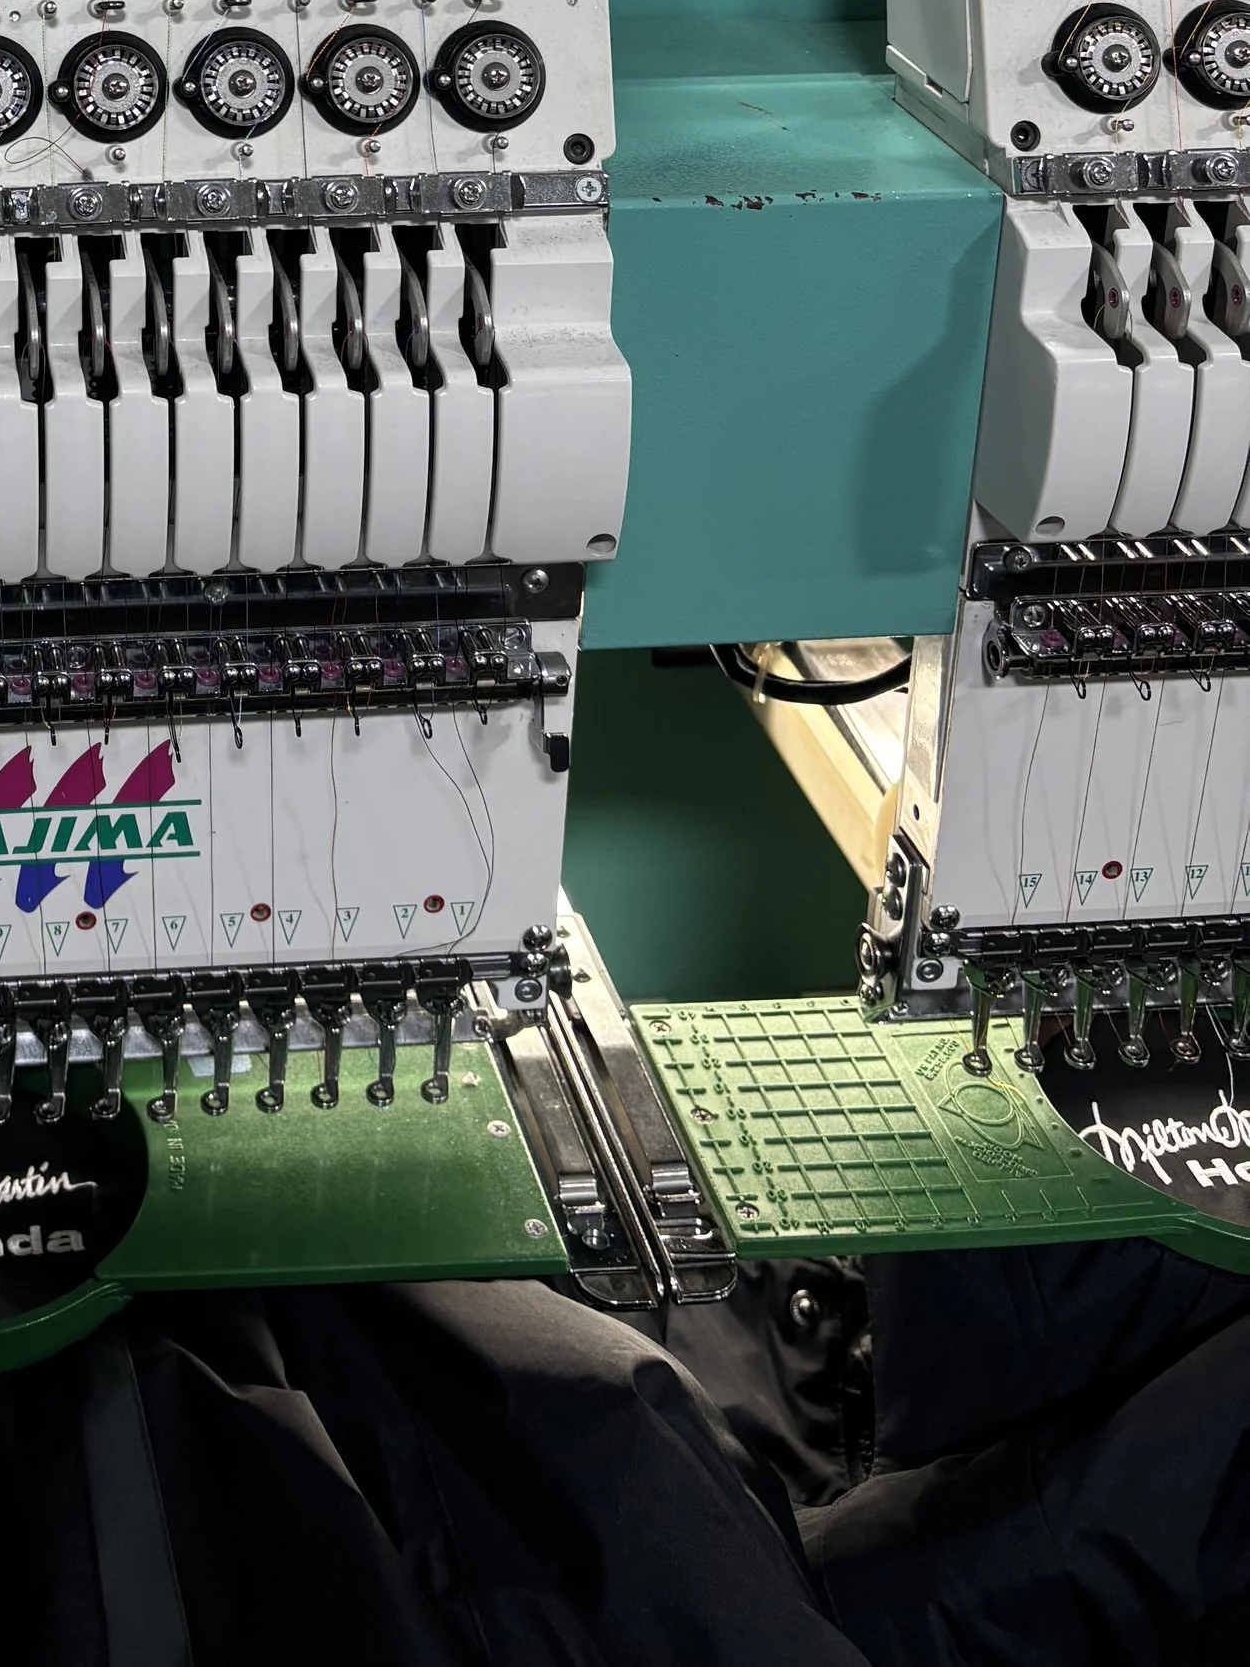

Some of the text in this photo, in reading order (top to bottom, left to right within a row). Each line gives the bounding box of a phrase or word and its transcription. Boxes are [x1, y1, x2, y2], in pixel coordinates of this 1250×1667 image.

[1023, 877, 1037, 887] 15
[1078, 874, 1092, 884] 14
[1134, 871, 1148, 882] 13
[1189, 868, 1203, 878] 12
[53, 925, 62, 936] 8
[111, 922, 120, 933] 7
[170, 919, 178, 930] 6
[228, 916, 236, 928] 5
[285, 913, 294, 924] 4
[343, 910, 352, 921] 3
[400, 907, 409, 919] 2
[458, 905, 466, 916] 1
